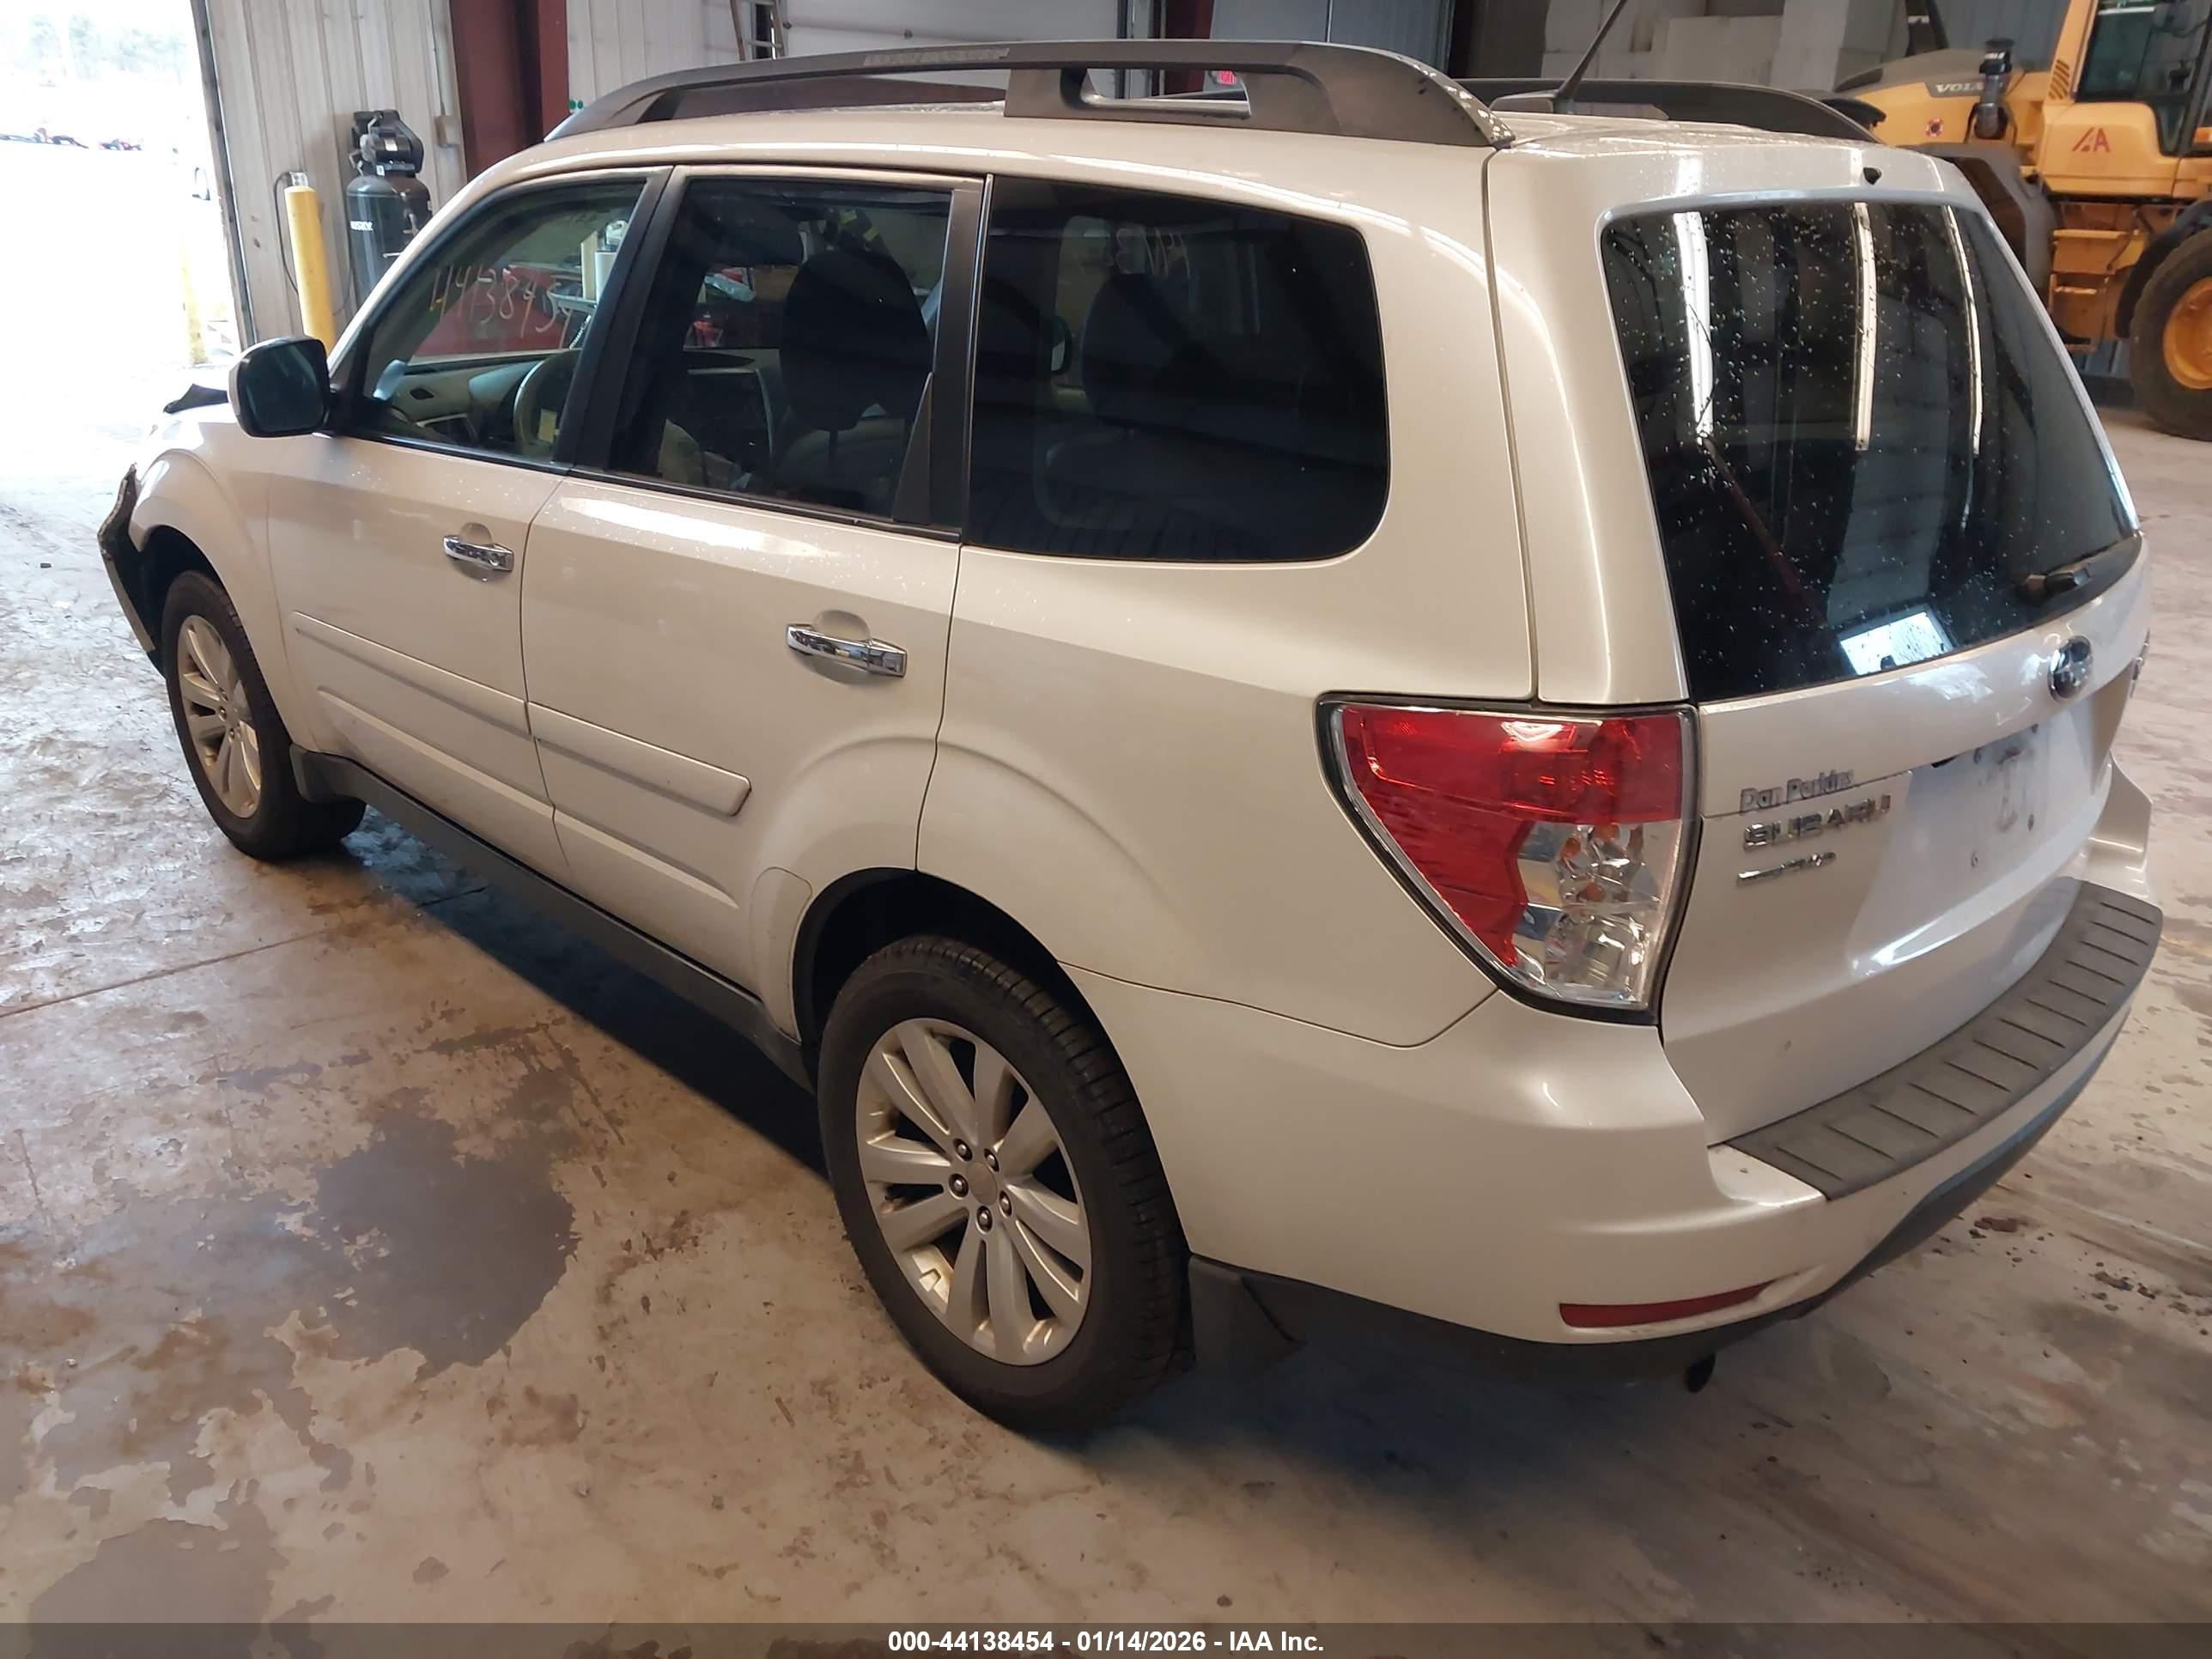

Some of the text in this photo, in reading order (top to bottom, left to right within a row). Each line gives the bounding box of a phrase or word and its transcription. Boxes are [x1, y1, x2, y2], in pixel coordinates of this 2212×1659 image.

[1936, 82, 1984, 93] VOL
[1740, 787, 1784, 814] Dan
[1743, 794, 1892, 848] SUBARU
